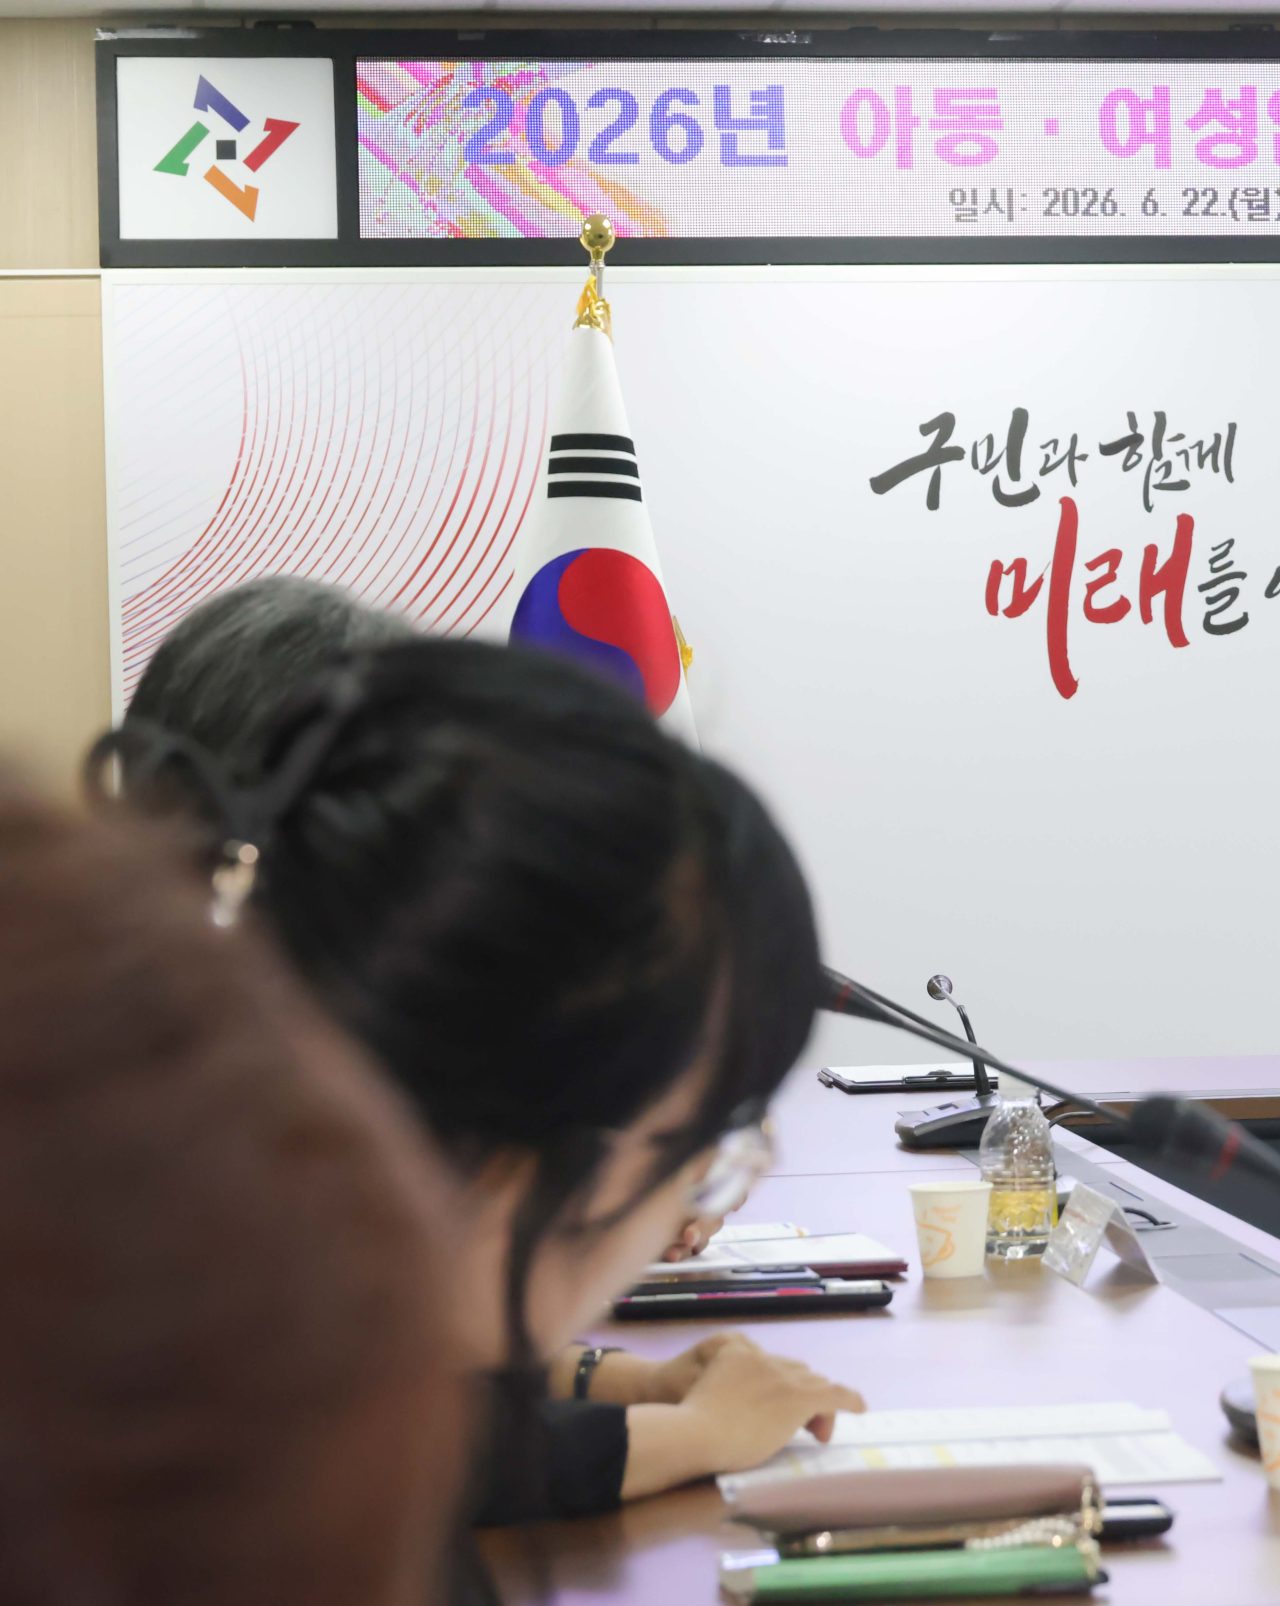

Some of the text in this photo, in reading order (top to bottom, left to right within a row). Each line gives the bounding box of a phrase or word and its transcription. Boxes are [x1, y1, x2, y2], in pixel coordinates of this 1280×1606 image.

[462, 85, 788, 167] 2026년
[839, 85, 1003, 170] 아동
[949, 187, 1028, 223] 일시:
[1042, 187, 1127, 217] 2026.
[1140, 187, 1168, 217] 6.
[869, 407, 1237, 513] 구민과 함께
[985, 496, 1249, 699] 미래를
